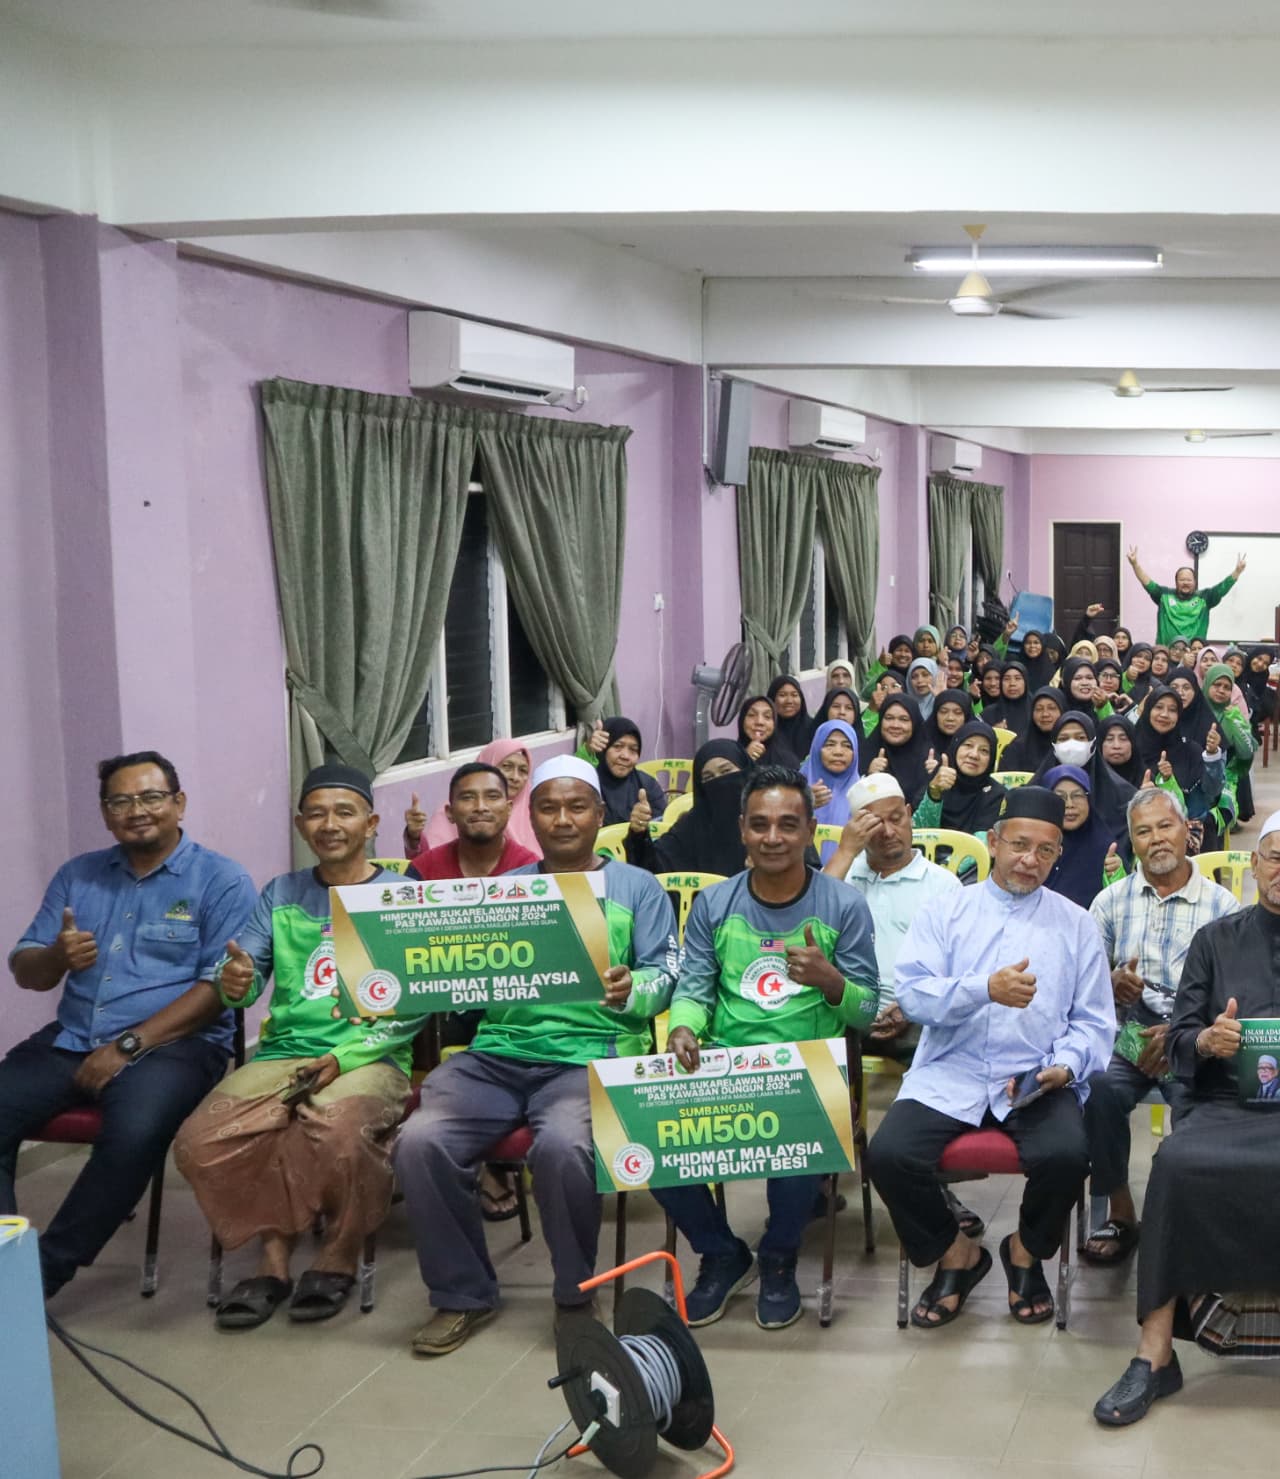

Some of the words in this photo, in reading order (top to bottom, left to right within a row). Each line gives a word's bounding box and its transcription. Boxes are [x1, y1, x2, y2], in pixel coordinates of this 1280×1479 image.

[667, 877, 699, 888] MLKS
[380, 911, 438, 922] HIMPUNAN
[440, 906, 520, 918] SUKARELAWAN
[522, 904, 560, 913] BANJIR
[395, 920, 416, 929] PAS
[418, 916, 472, 927] KAWASAN
[474, 914, 520, 924] DUNGUN
[522, 912, 547, 920] 2024
[429, 932, 508, 946] SUMBANGAN
[404, 940, 535, 975] RM500
[409, 977, 488, 994] KHIDMAT
[493, 971, 580, 988] MALAYSIA
[452, 991, 488, 1004] DUN
[493, 987, 540, 1001] SURA
[634, 1082, 687, 1095] HIMPUNAN
[689, 1076, 764, 1090] SUKARELAWAN
[767, 1072, 803, 1083] BANJIR
[648, 1092, 667, 1102] PAS
[669, 1087, 719, 1100] KAWASAN
[721, 1084, 764, 1095] DUNGUN
[766, 1081, 790, 1091] 2024
[679, 1103, 754, 1118] SUMBANGAN
[657, 1110, 780, 1148] RM500
[662, 1149, 736, 1168] KHIDMAT
[740, 1142, 824, 1161] MALAYSIA
[679, 1164, 715, 1179] DUN
[718, 1160, 768, 1176] BUKIT
[771, 1156, 808, 1170] BESI
